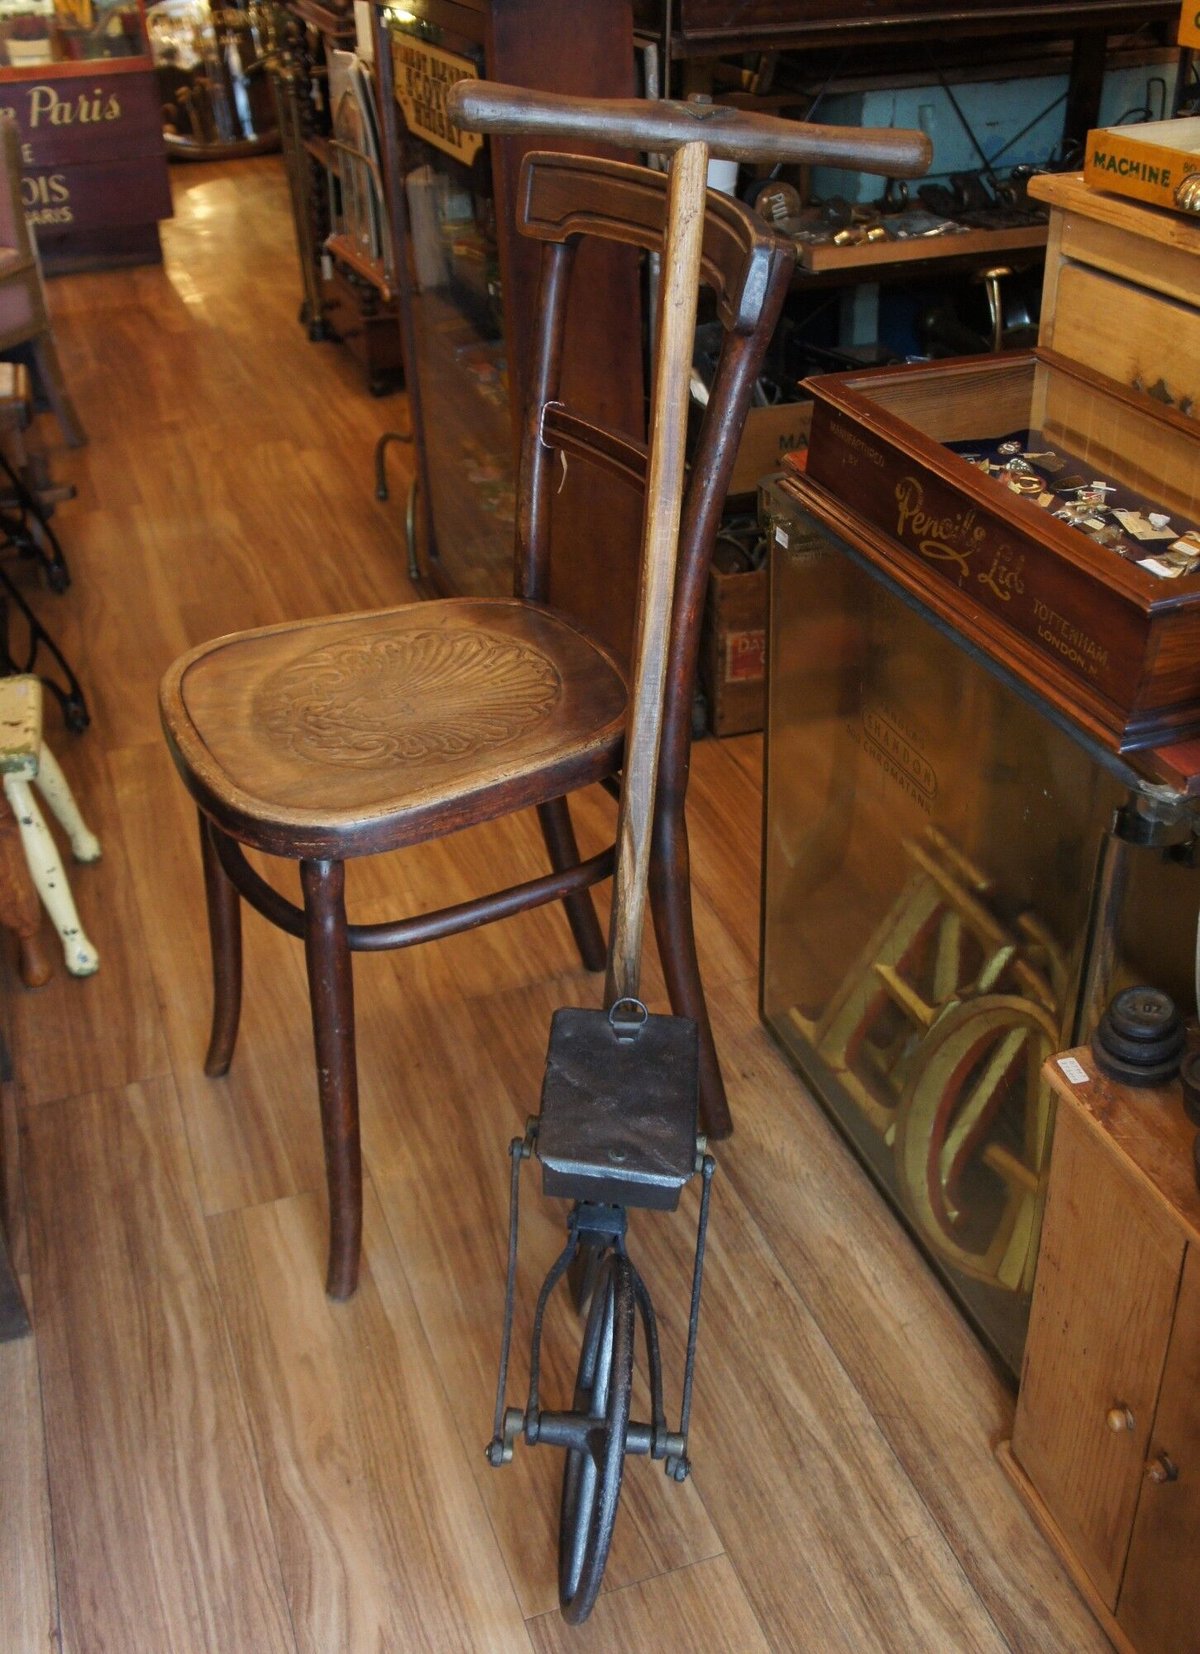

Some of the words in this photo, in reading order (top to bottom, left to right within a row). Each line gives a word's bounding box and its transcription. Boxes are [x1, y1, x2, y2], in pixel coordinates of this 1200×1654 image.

[26, 85, 122, 129] Paris
[1093, 151, 1171, 188] MACHINE
[1033, 597, 1109, 670] TOTTENHAM
[863, 740, 931, 816] CHROMATANK
[866, 712, 931, 787] SHANDON
